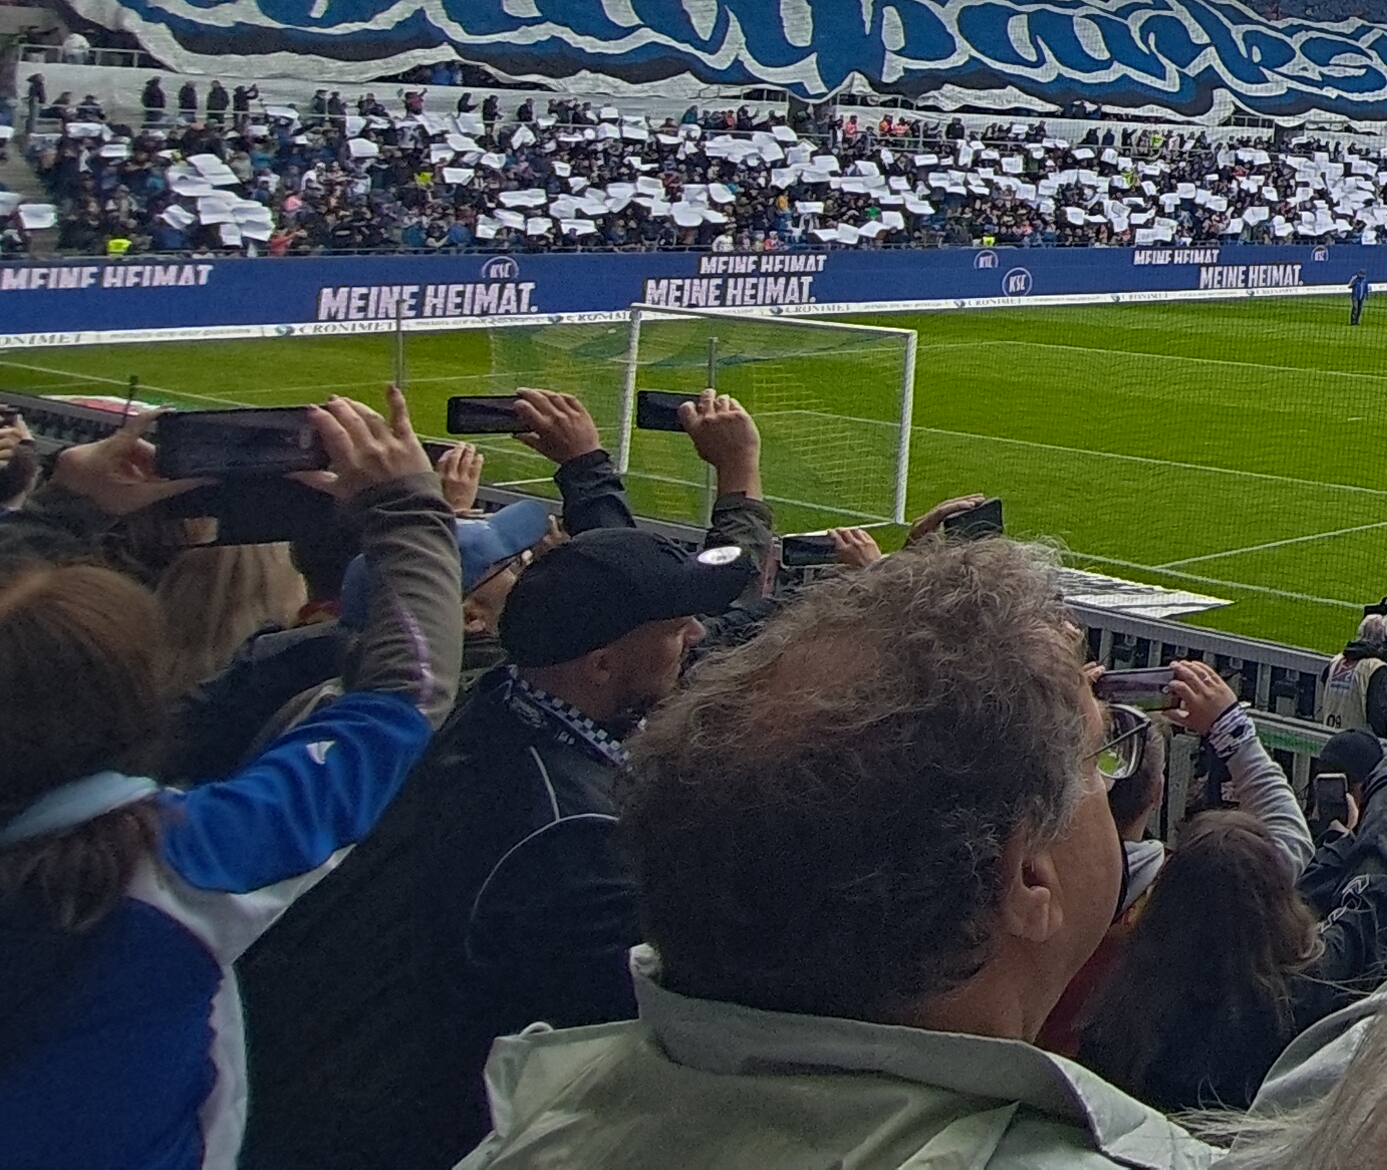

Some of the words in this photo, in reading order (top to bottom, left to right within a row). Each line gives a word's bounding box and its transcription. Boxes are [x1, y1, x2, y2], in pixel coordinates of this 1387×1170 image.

[645, 277, 722, 308] MEINE
[724, 276, 817, 306] HEIMAT.
[1199, 266, 1247, 290] MEINE
[318, 284, 420, 321] MEINE
[422, 281, 539, 317] HEIMAT.
